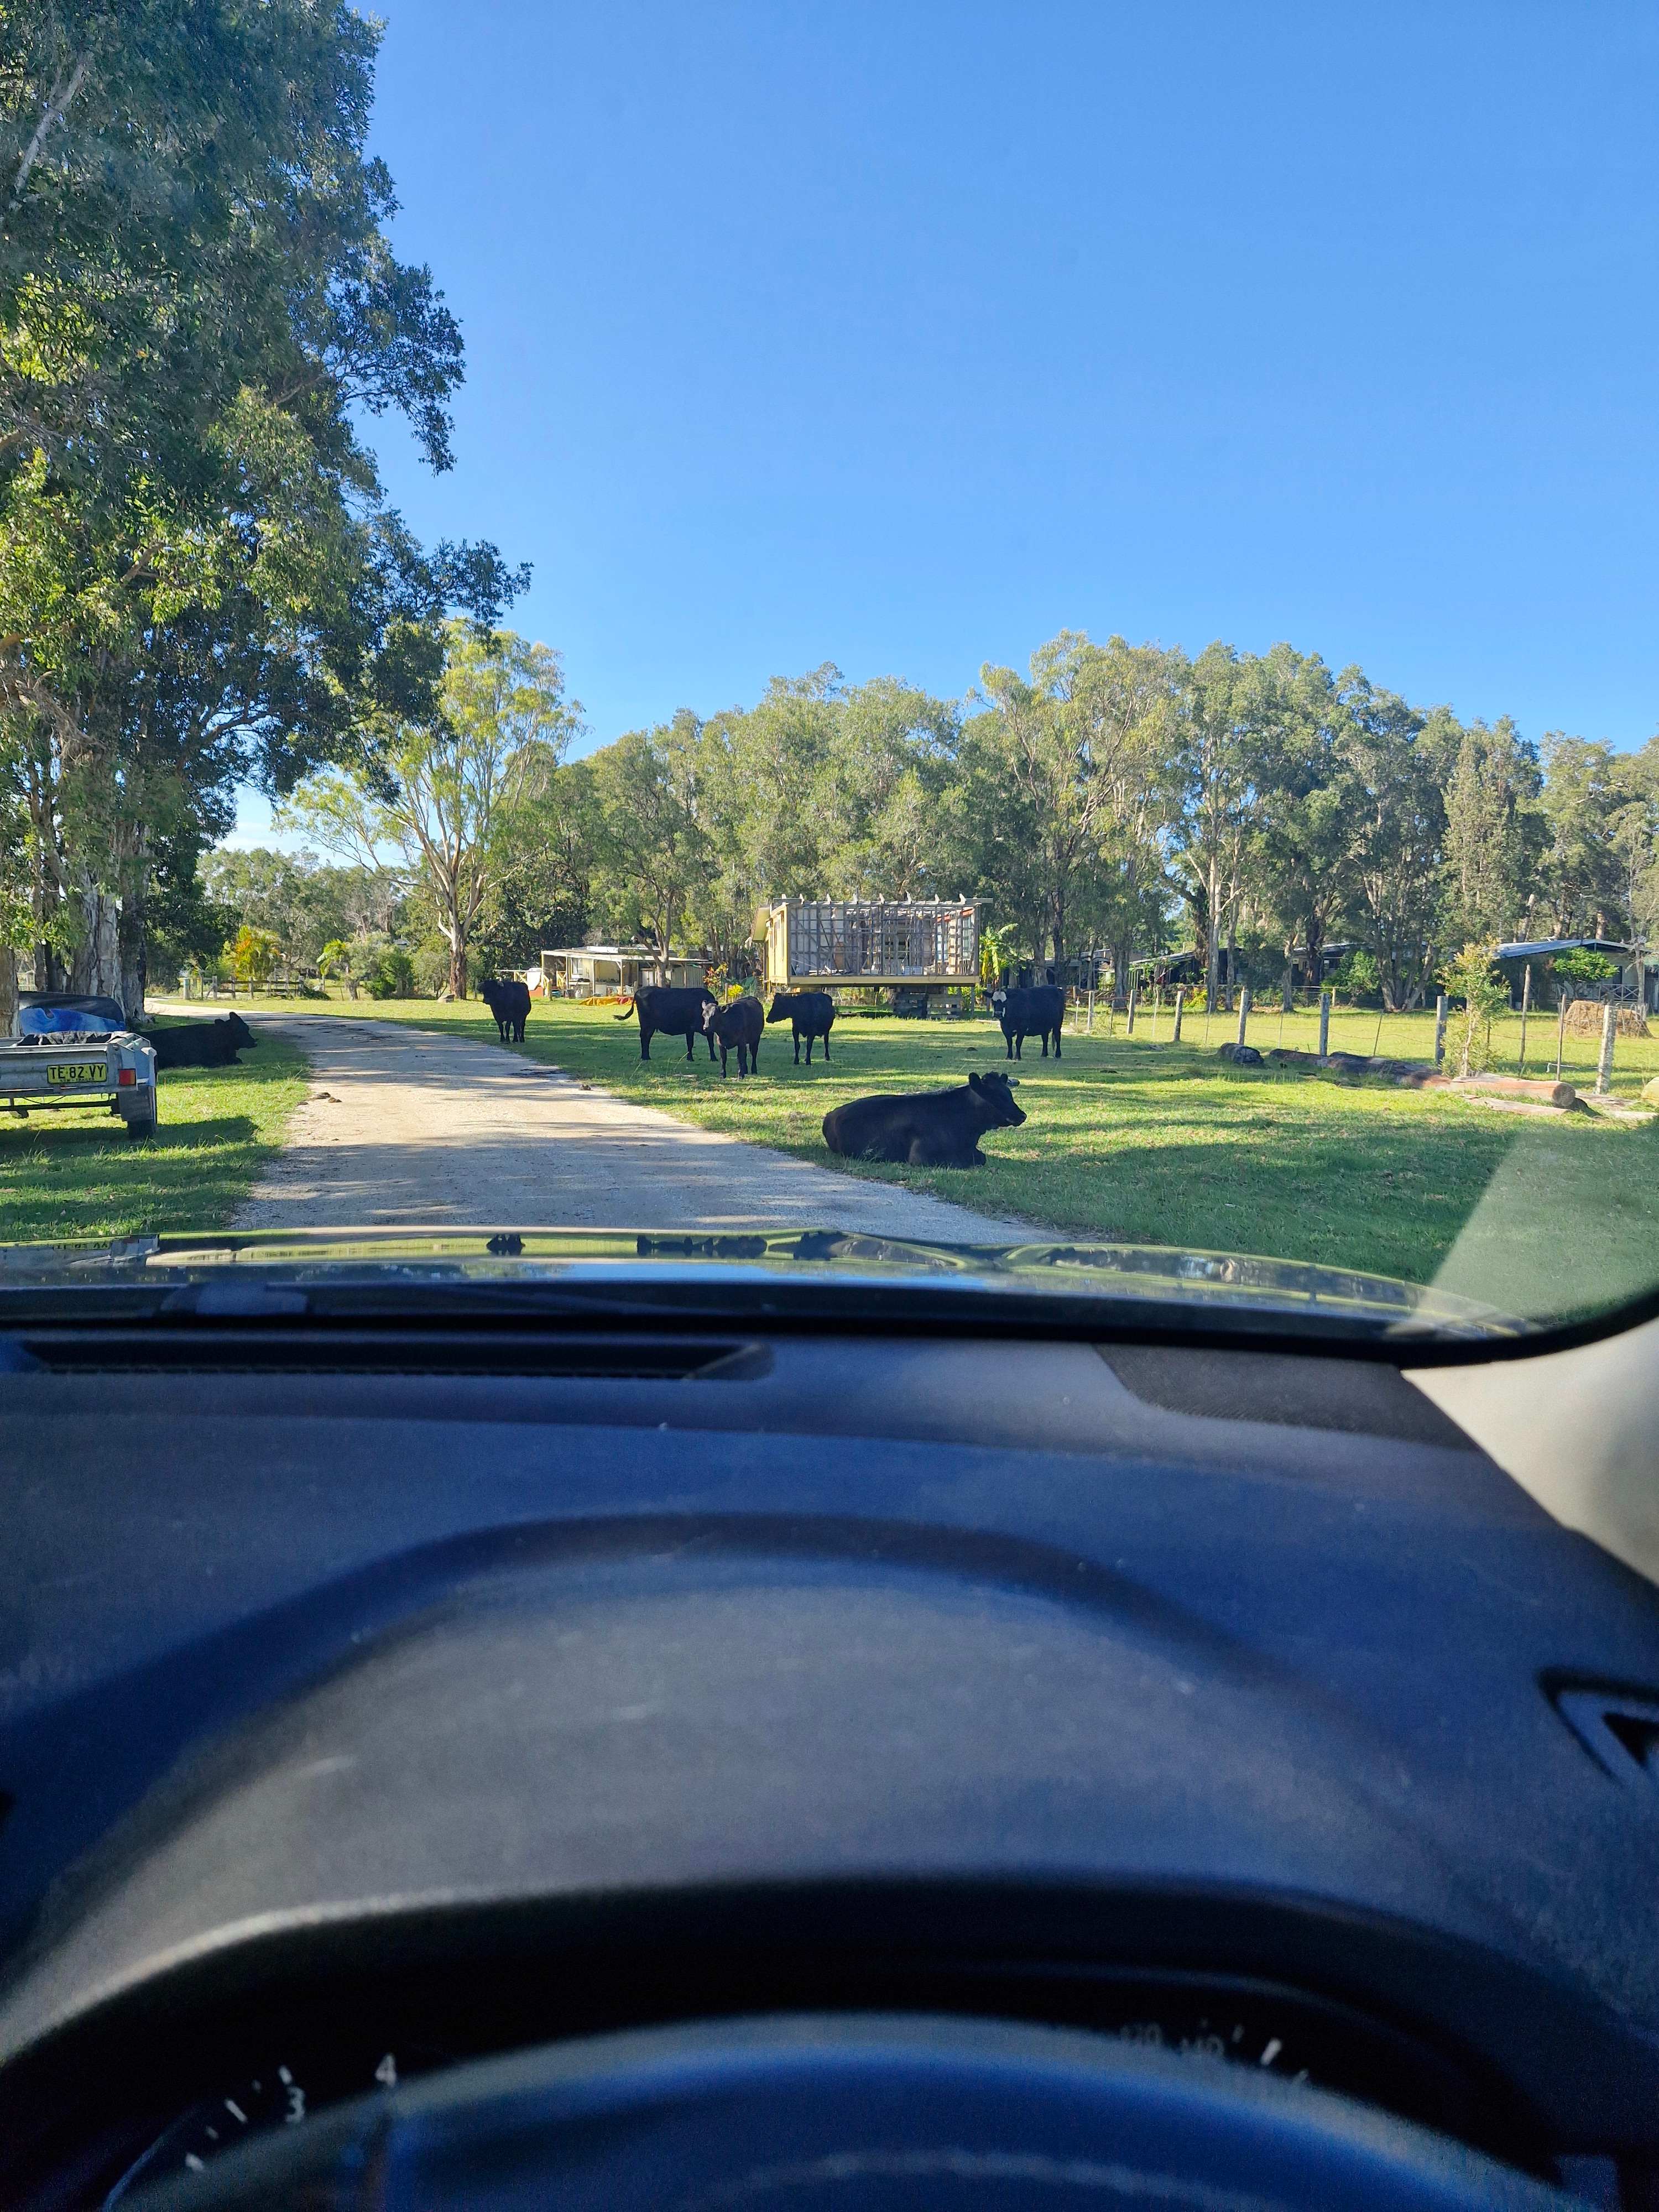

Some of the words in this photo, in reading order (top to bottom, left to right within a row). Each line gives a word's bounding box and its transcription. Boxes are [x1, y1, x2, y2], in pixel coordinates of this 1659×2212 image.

[50, 1066, 66, 1079] TE
[69, 1066, 84, 1078] 82
[88, 1065, 104, 1078] VY
[374, 2053, 397, 2088] 4
[285, 2086, 305, 2122] 3
